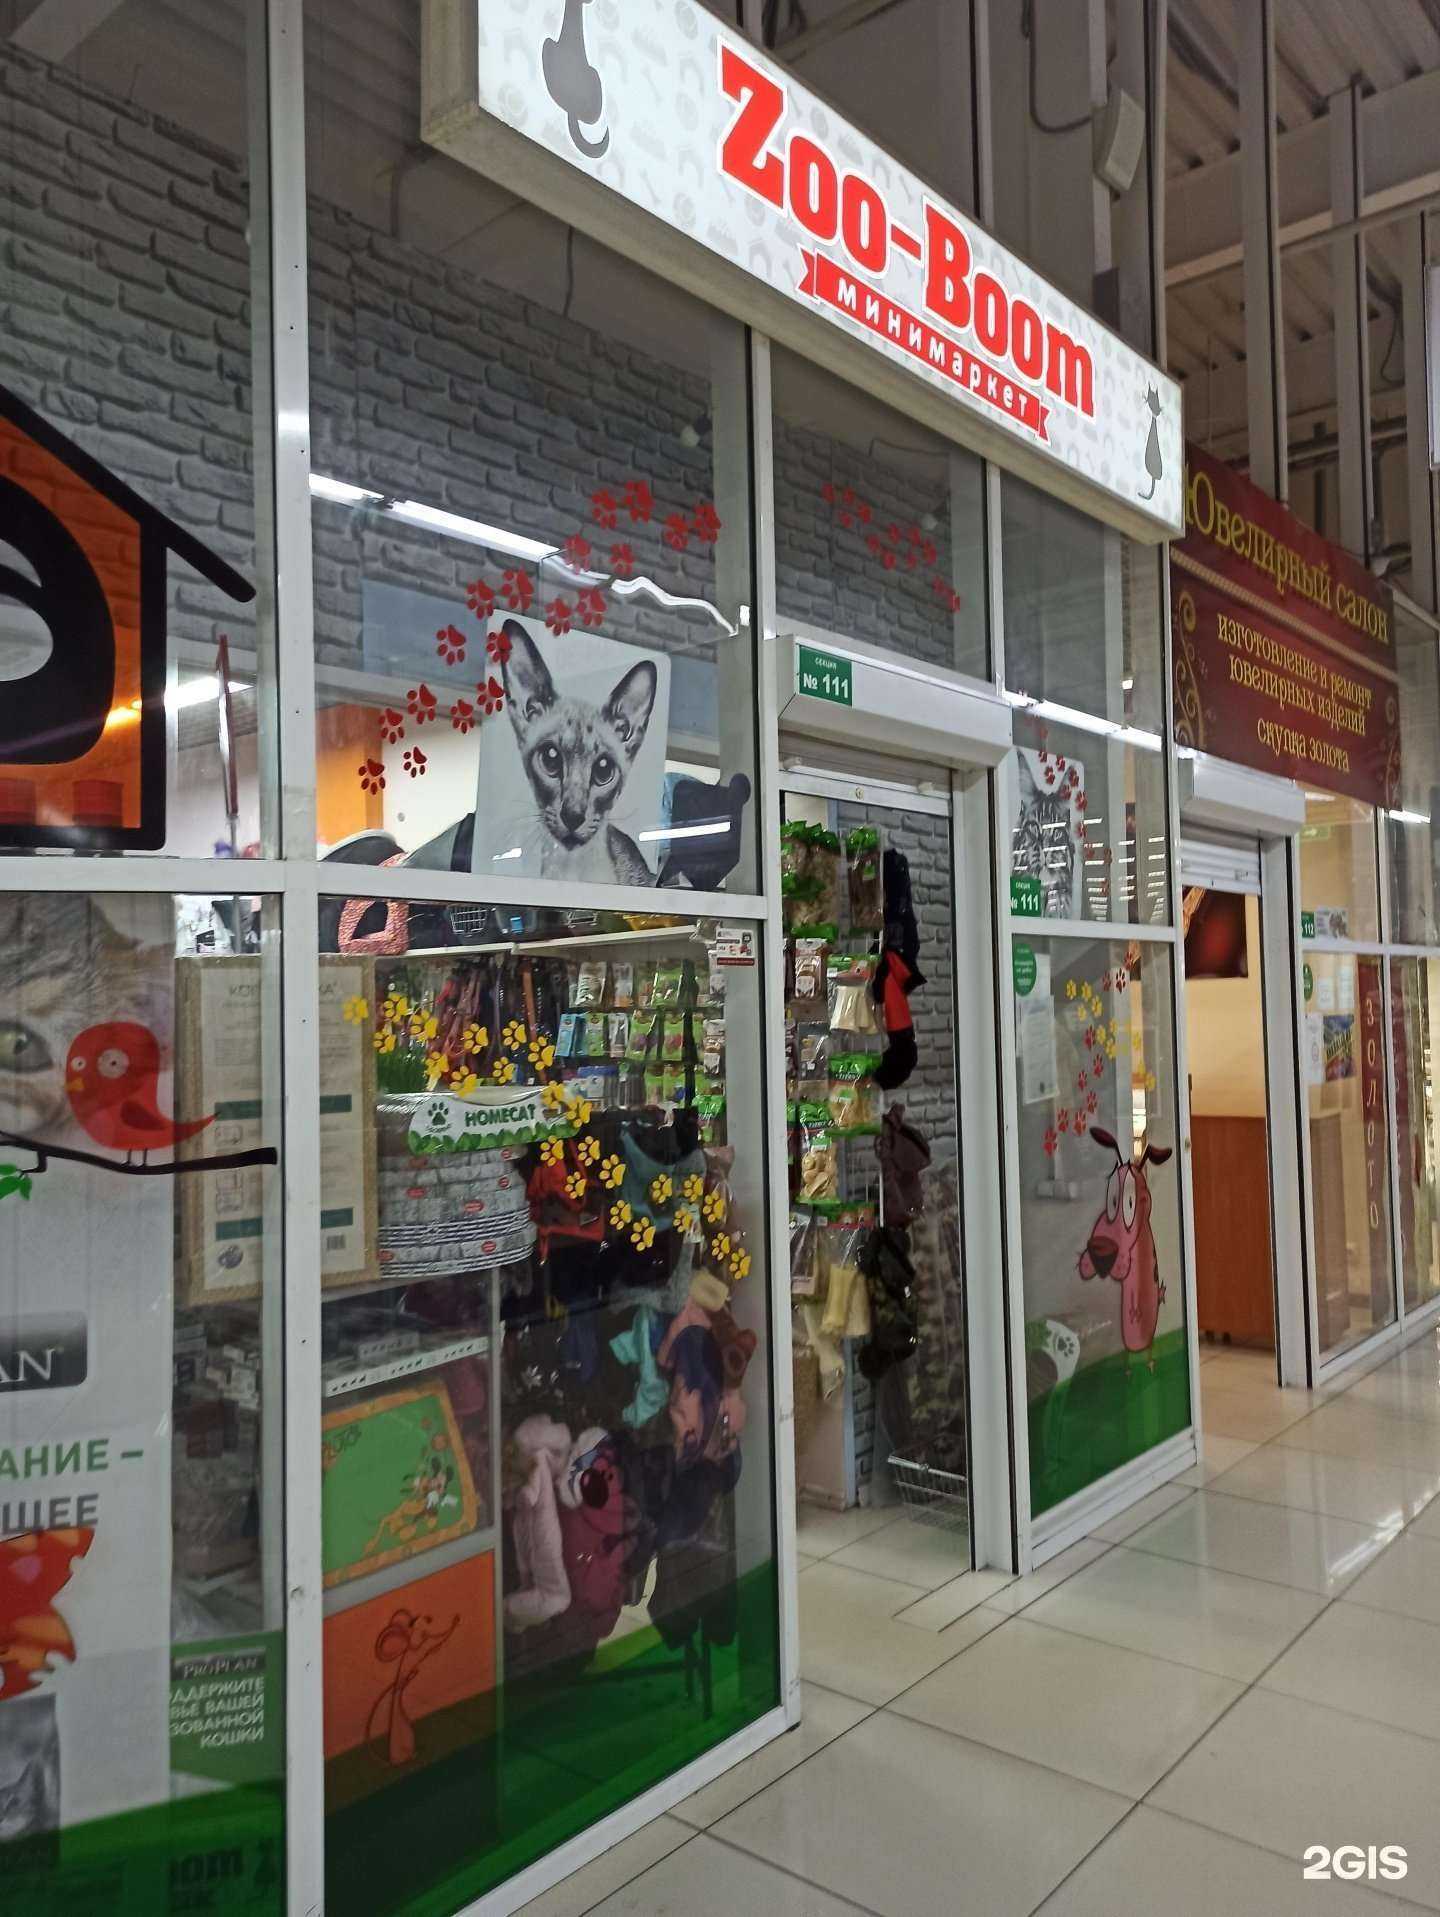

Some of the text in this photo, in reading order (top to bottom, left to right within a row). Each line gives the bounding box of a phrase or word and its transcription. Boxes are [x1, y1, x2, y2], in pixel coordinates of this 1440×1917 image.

[837, 277, 1029, 417] минимаркет
[1184, 463, 1390, 644] Ювелирный салон
[803, 672, 849, 699] № 111
[1217, 613, 1372, 710] изготовление и ремонт
[1228, 655, 1366, 737] ювелирных изделий
[1257, 717, 1350, 773] скупка золота
[1020, 893, 1040, 911] 111
[464, 1103, 536, 1128] HOMECAT
[1365, 997, 1380, 1229] ЗОЛОТО
[170, 1676, 265, 1704] ДДЕРЖИТЕ
[200, 1727, 265, 1749] КОШКИ
